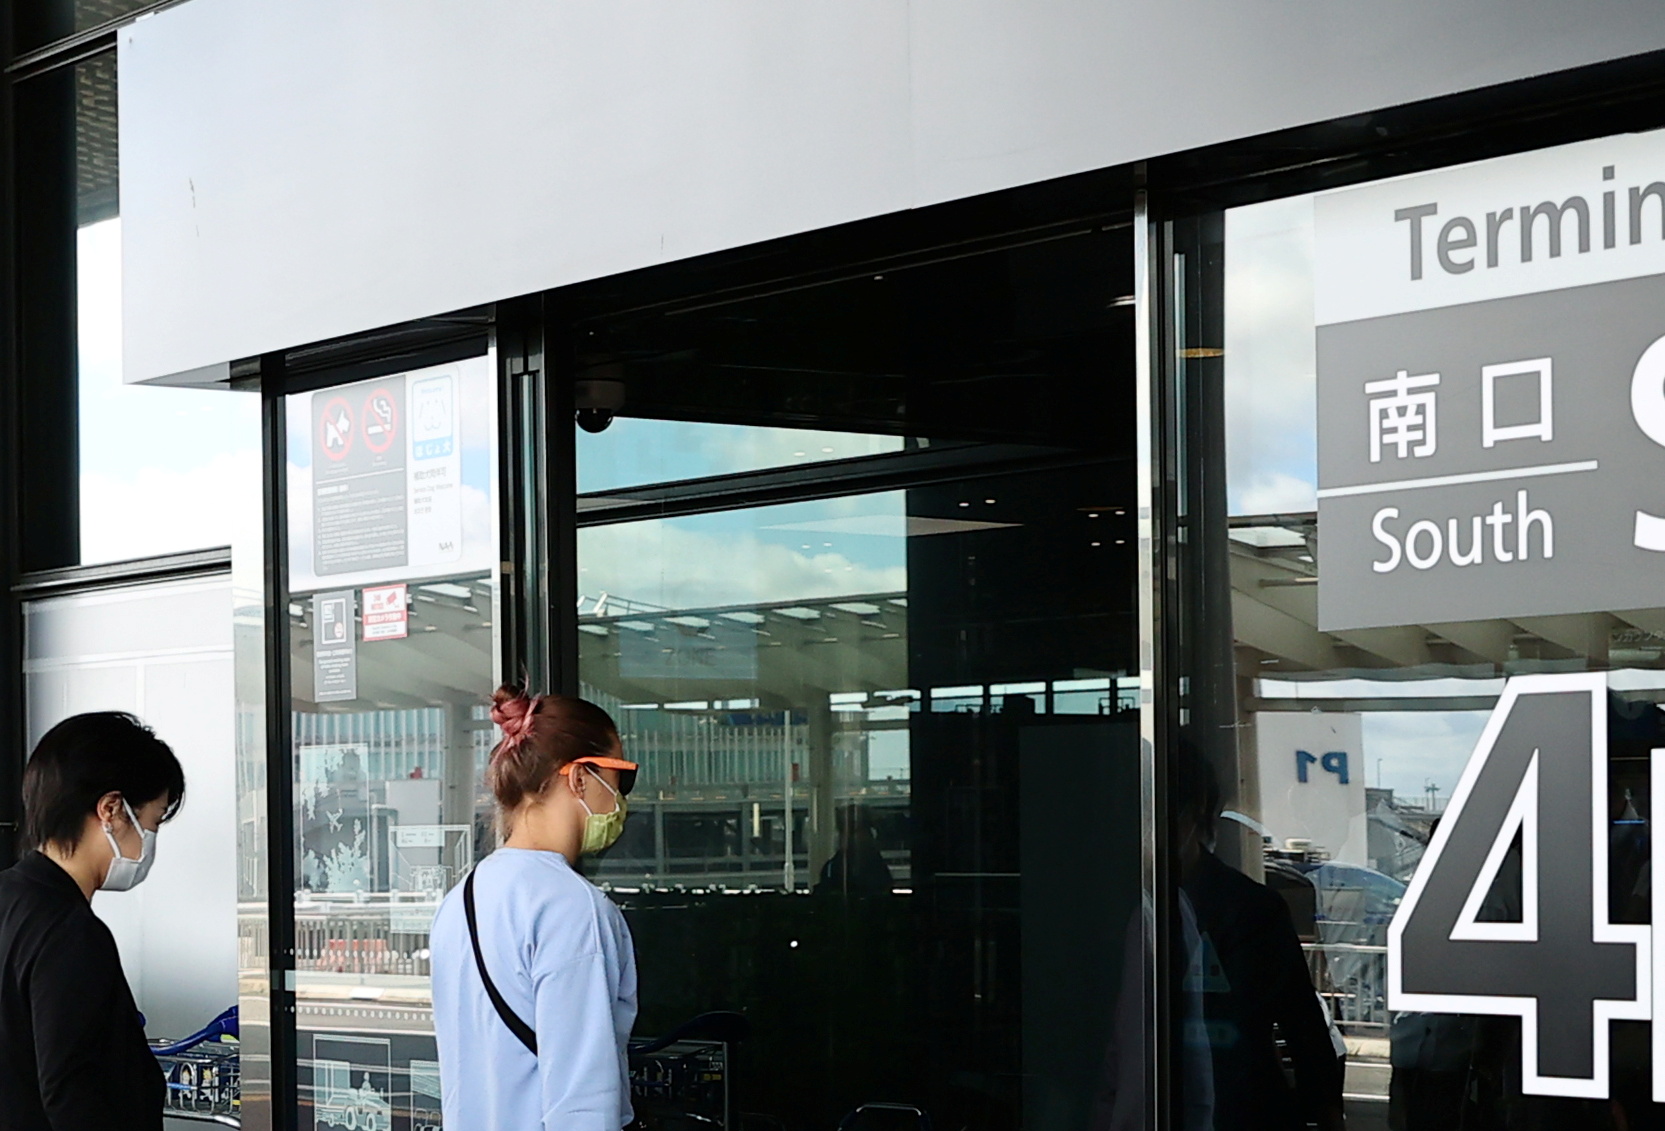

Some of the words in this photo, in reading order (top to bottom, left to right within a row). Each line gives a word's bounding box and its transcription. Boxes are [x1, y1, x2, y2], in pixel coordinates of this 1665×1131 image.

[1364, 356, 1553, 464] 南口
[1371, 489, 1554, 574] South
[1387, 672, 1665, 1102] 4
